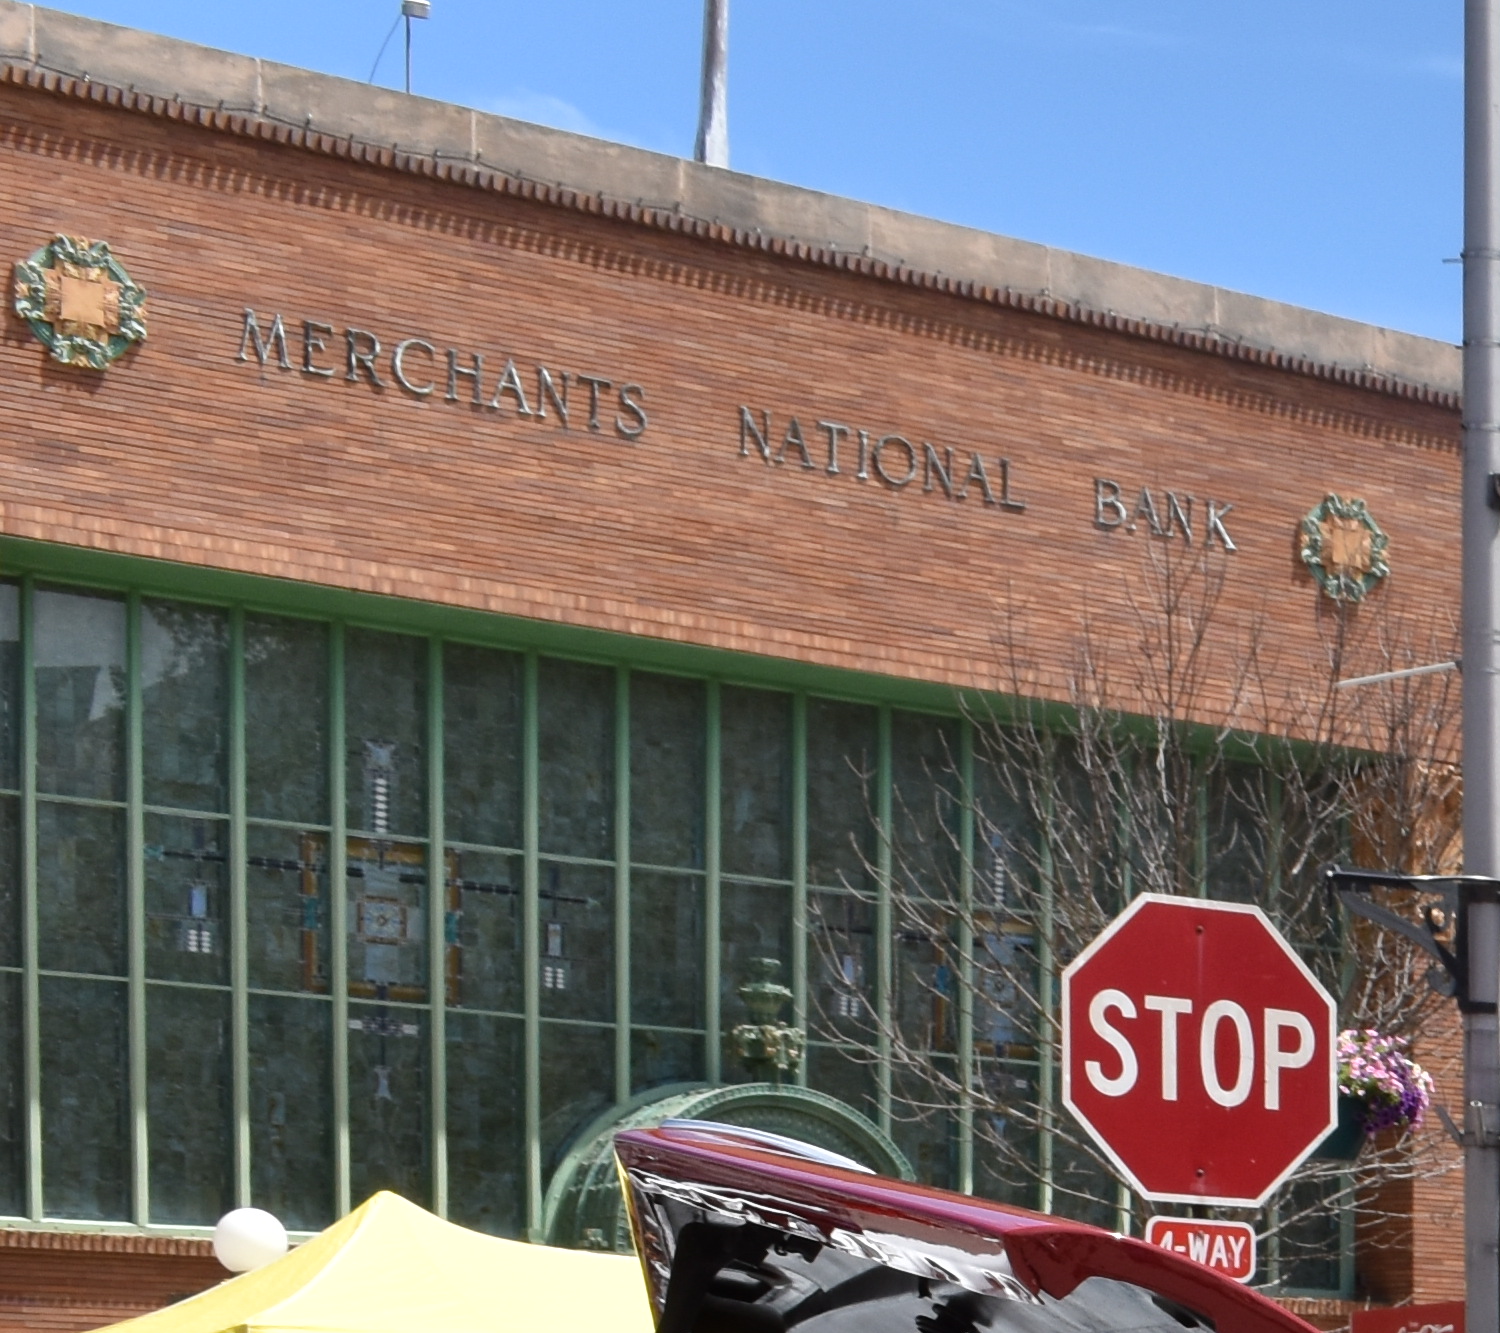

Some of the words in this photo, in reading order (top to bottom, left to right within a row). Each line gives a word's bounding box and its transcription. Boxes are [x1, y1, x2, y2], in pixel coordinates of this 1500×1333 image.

[236, 307, 648, 438] MERCHANTS
[738, 405, 1026, 511] NATIONAL
[1094, 478, 1236, 551] BANK
[1084, 989, 1314, 1110] STOP
